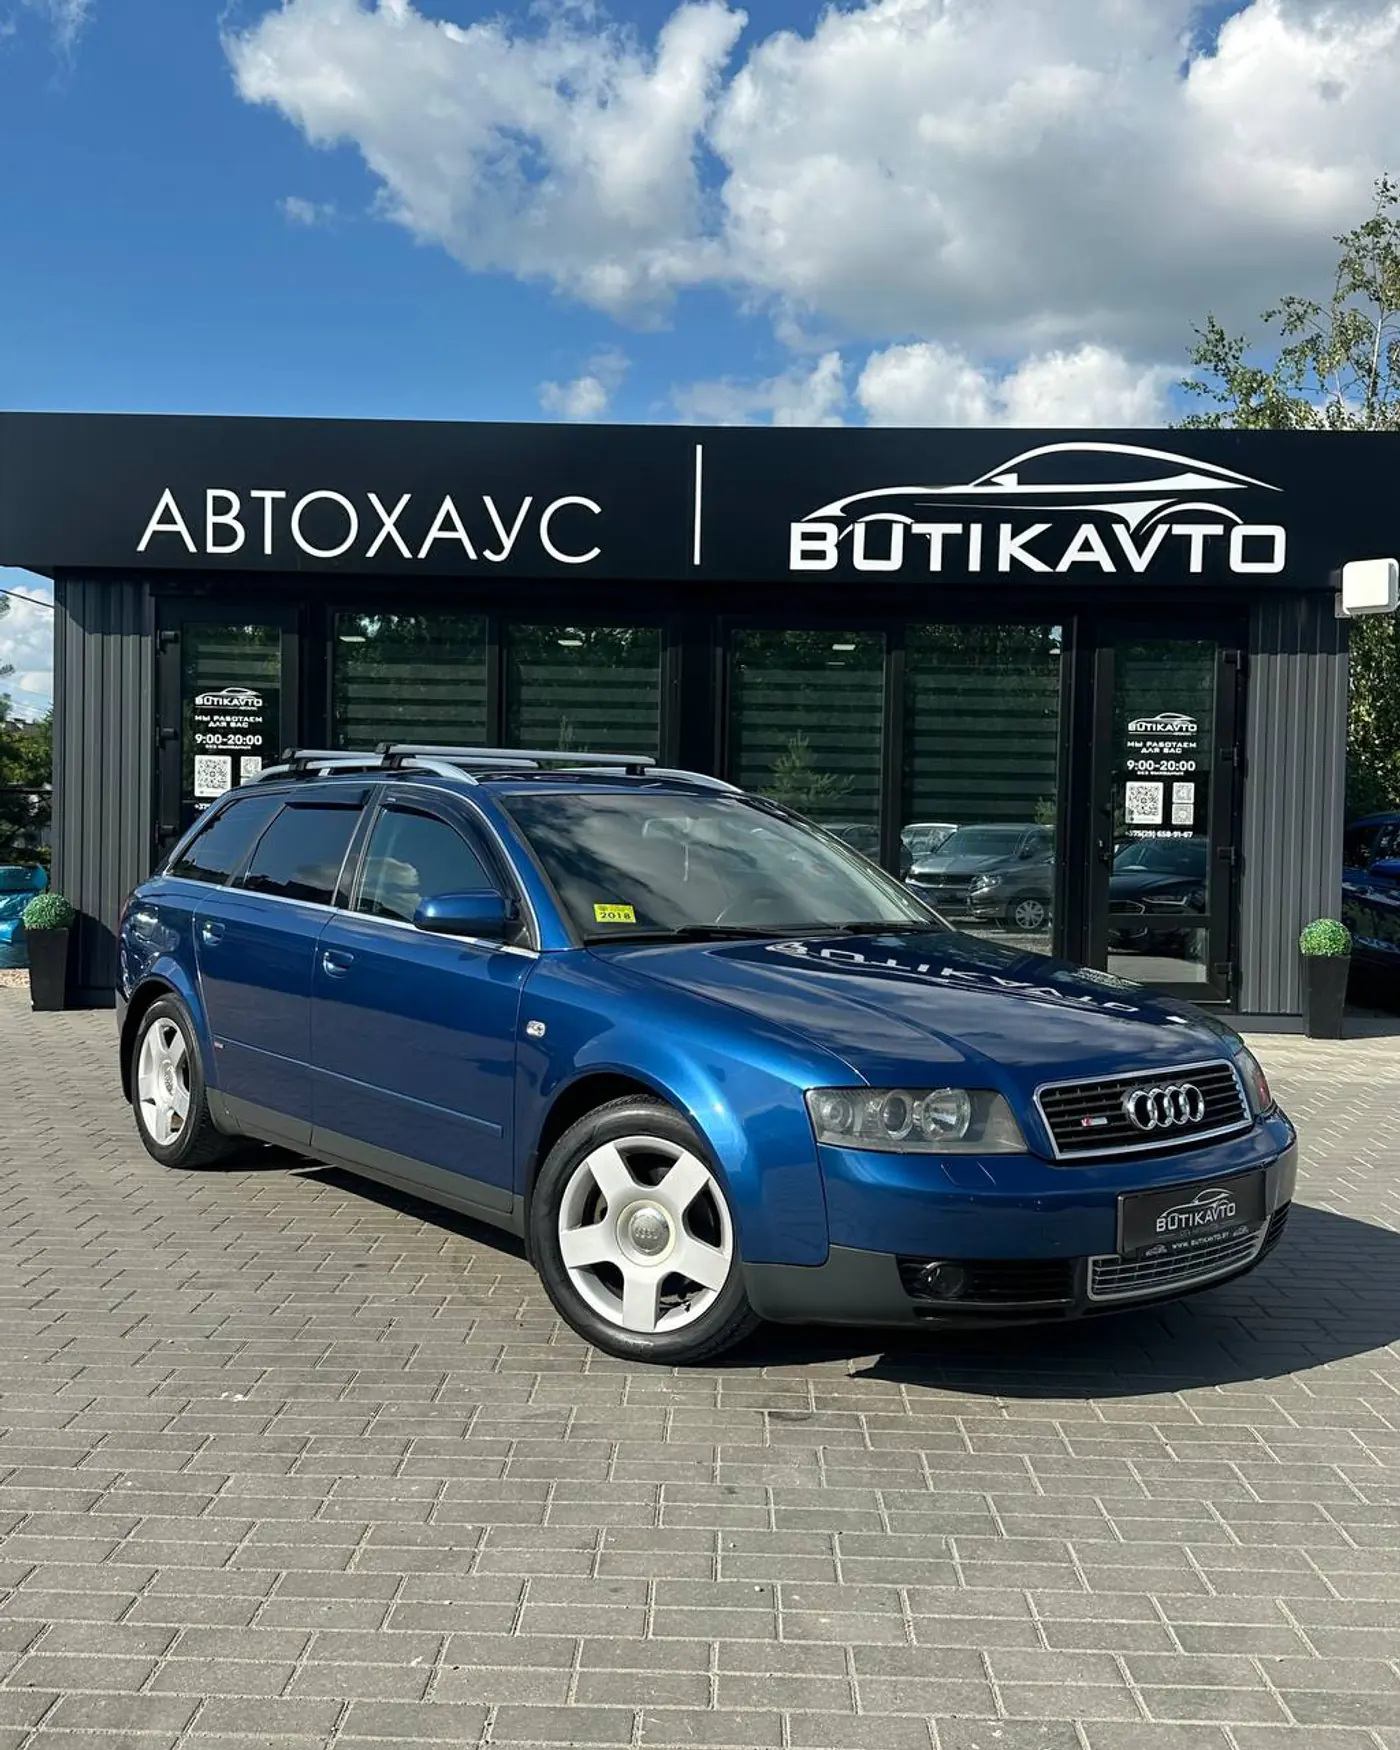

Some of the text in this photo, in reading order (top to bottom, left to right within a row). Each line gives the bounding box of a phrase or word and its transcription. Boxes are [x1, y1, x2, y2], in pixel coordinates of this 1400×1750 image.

[137, 488, 602, 564] АВТОХАУС
[790, 522, 1287, 574] BUTIKAVTO
[195, 733, 263, 745] 9:00-20:00
[1127, 760, 1196, 772] 9:00-20:00
[1156, 1202, 1236, 1233] BUTIKAVTO
